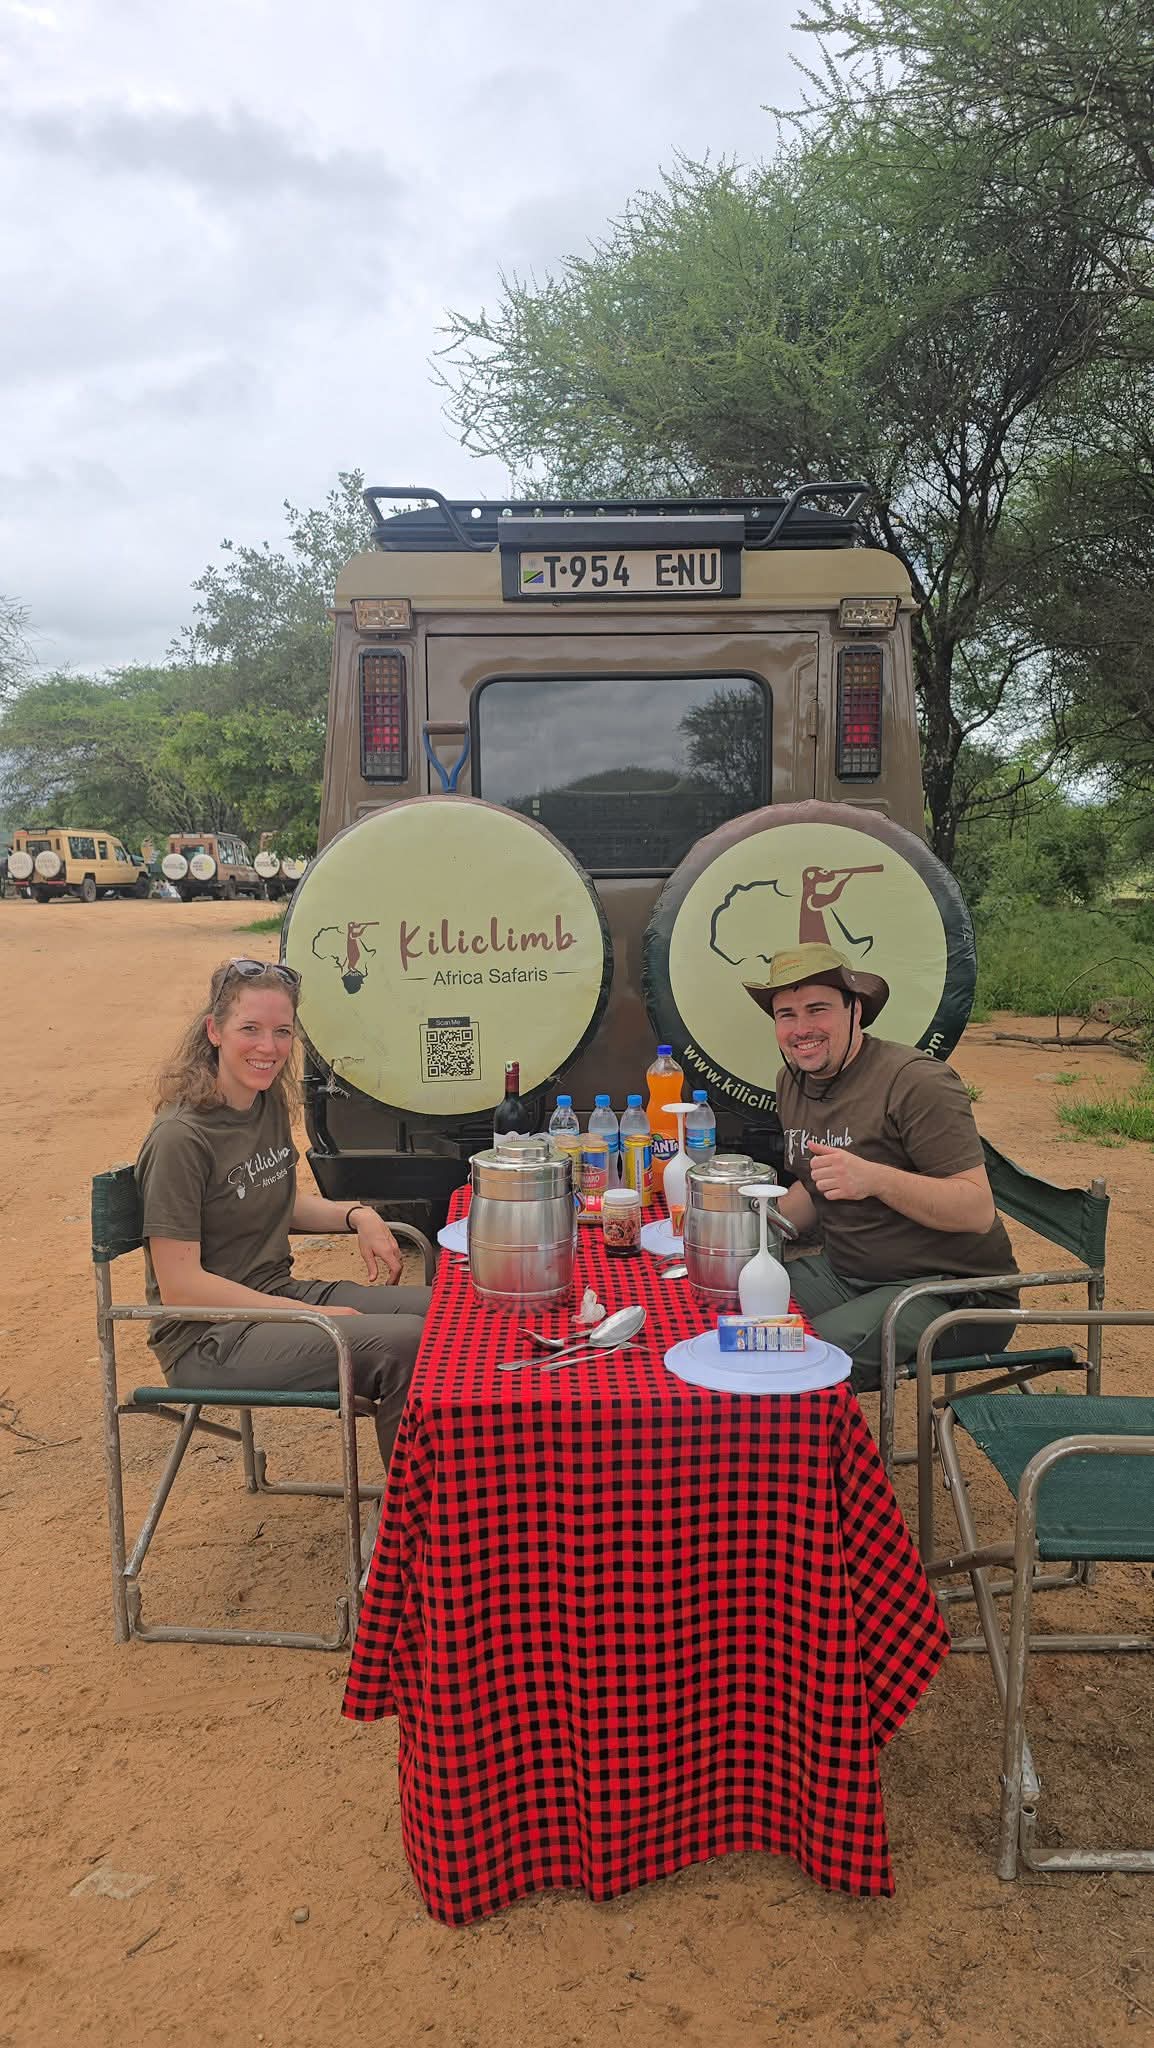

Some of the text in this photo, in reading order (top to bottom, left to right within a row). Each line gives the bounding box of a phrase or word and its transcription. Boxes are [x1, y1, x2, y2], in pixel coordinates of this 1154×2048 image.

[399, 914, 577, 972] Kiliclimb
[433, 966, 549, 986] Africa Safaris
[651, 1139, 680, 1154] ANTA
